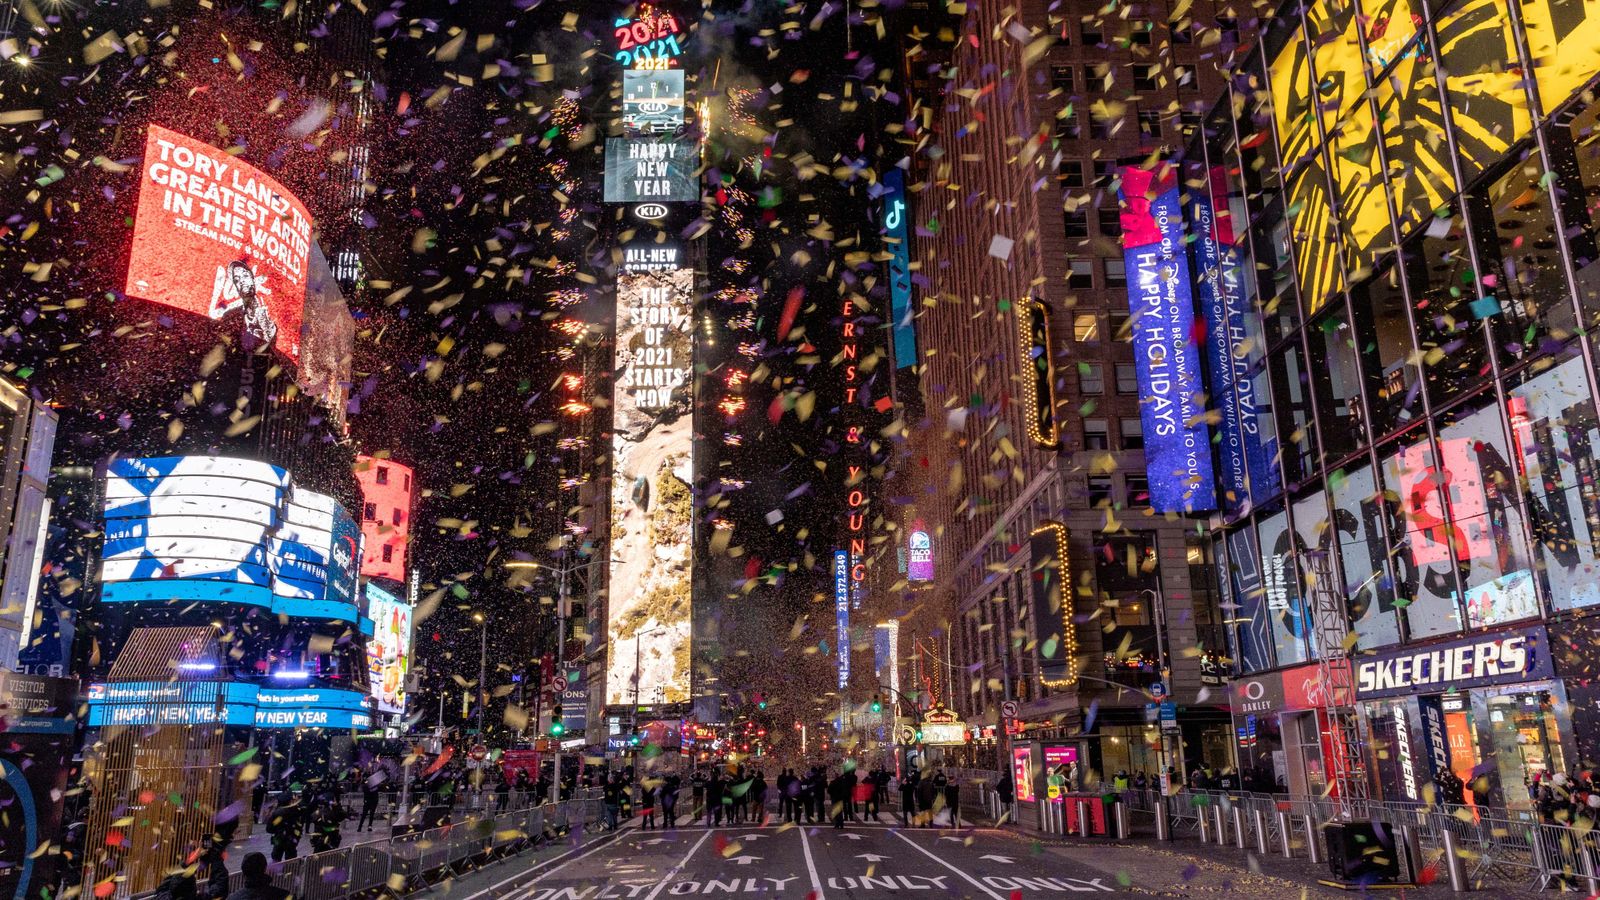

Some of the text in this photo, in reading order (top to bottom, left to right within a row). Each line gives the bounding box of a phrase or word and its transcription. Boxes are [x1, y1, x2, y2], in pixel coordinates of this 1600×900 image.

[635, 57, 669, 70] 2021
[643, 103, 664, 111] KIA
[629, 143, 677, 159] HAPPY
[636, 162, 669, 177] NEW
[157, 139, 311, 241] TORY LANEZ THE
[634, 180, 671, 196] YEAR
[149, 163, 310, 262] GREATEST ARTIST
[163, 190, 193, 217] IN
[200, 203, 246, 238] THE
[640, 207, 662, 215] KIA
[1157, 205, 1170, 235] FROM
[174, 218, 243, 250] STREAM NOW
[626, 249, 677, 262] ALL-NEW
[1161, 237, 1173, 260] OUR
[1163, 262, 1180, 303] Disney
[641, 287, 669, 304] THE
[630, 307, 680, 325] STORY
[1169, 305, 1181, 323] ON
[645, 327, 664, 345] OF
[1137, 253, 1176, 436] HAPPY HOLIDAYS
[635, 348, 672, 366] 2021
[842, 301, 857, 404] ERNST
[1171, 327, 1188, 388] BROADWAY
[624, 368, 684, 387] STARTS
[635, 389, 672, 407] NOW
[846, 426, 859, 443] &
[1183, 432, 1195, 448] TO
[848, 466, 864, 581] YOUNG
[836, 554, 847, 612] 212.372.2349
[1358, 637, 1528, 692] SKECHERS
[9, 680, 45, 693] VISITOR
[7, 697, 50, 711] SERVICES
[1242, 701, 1271, 712] OAKLEY
[267, 712, 295, 724] NEW
[298, 711, 328, 723] YEAR
[1393, 705, 1417, 800] SKECHERS
[669, 876, 800, 895] ONLY
[827, 875, 950, 890] ONLY
[981, 876, 1115, 892] ONLY
